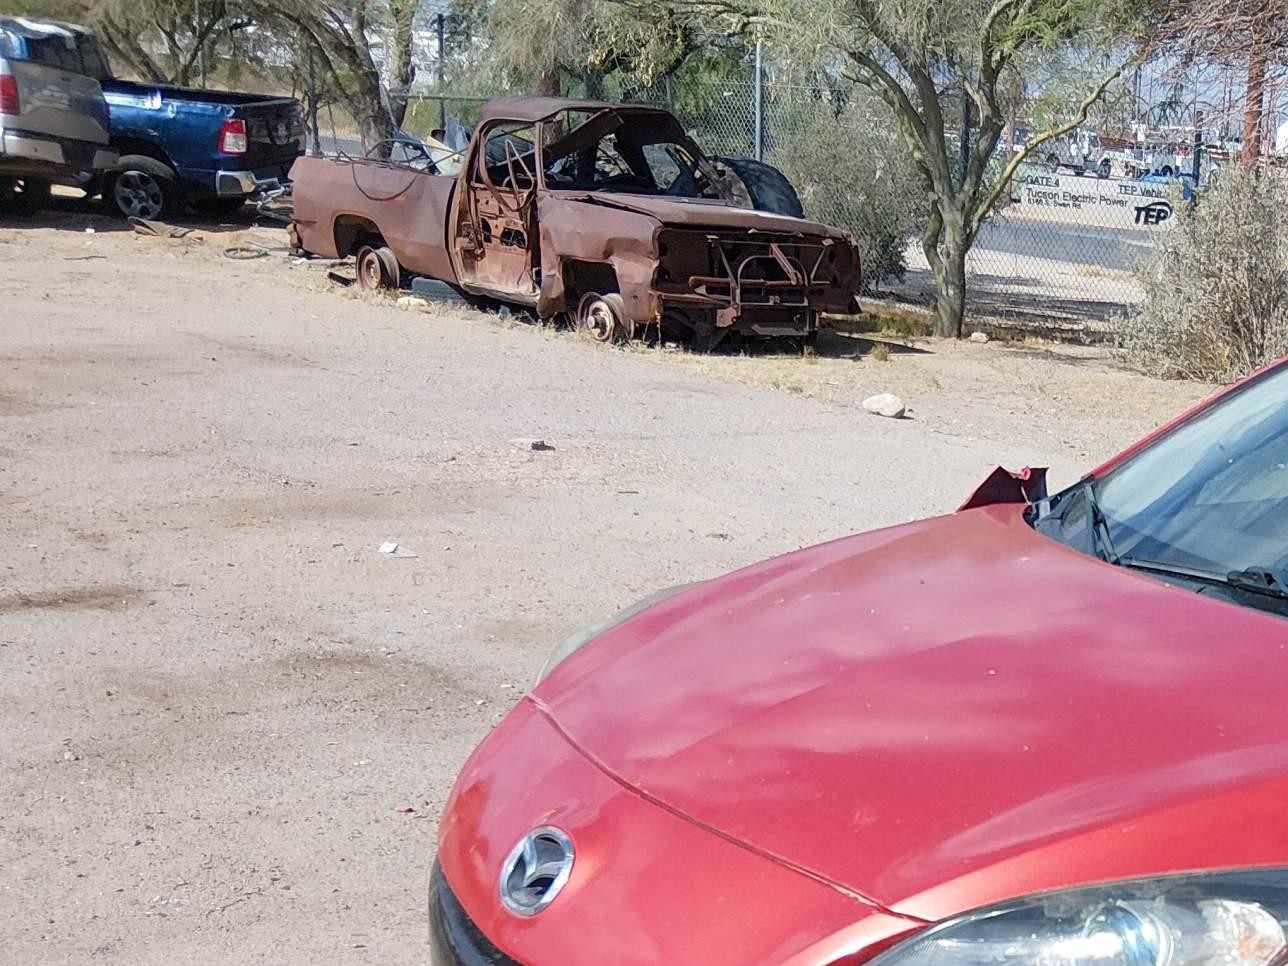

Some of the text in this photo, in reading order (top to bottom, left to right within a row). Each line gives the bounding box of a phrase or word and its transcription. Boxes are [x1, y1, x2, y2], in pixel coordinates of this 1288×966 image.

[1026, 175, 1052, 186] GATE
[1118, 184, 1138, 195] TEP
[1026, 188, 1128, 208] Tucson Electric Power
[1134, 206, 1170, 225] TEP
